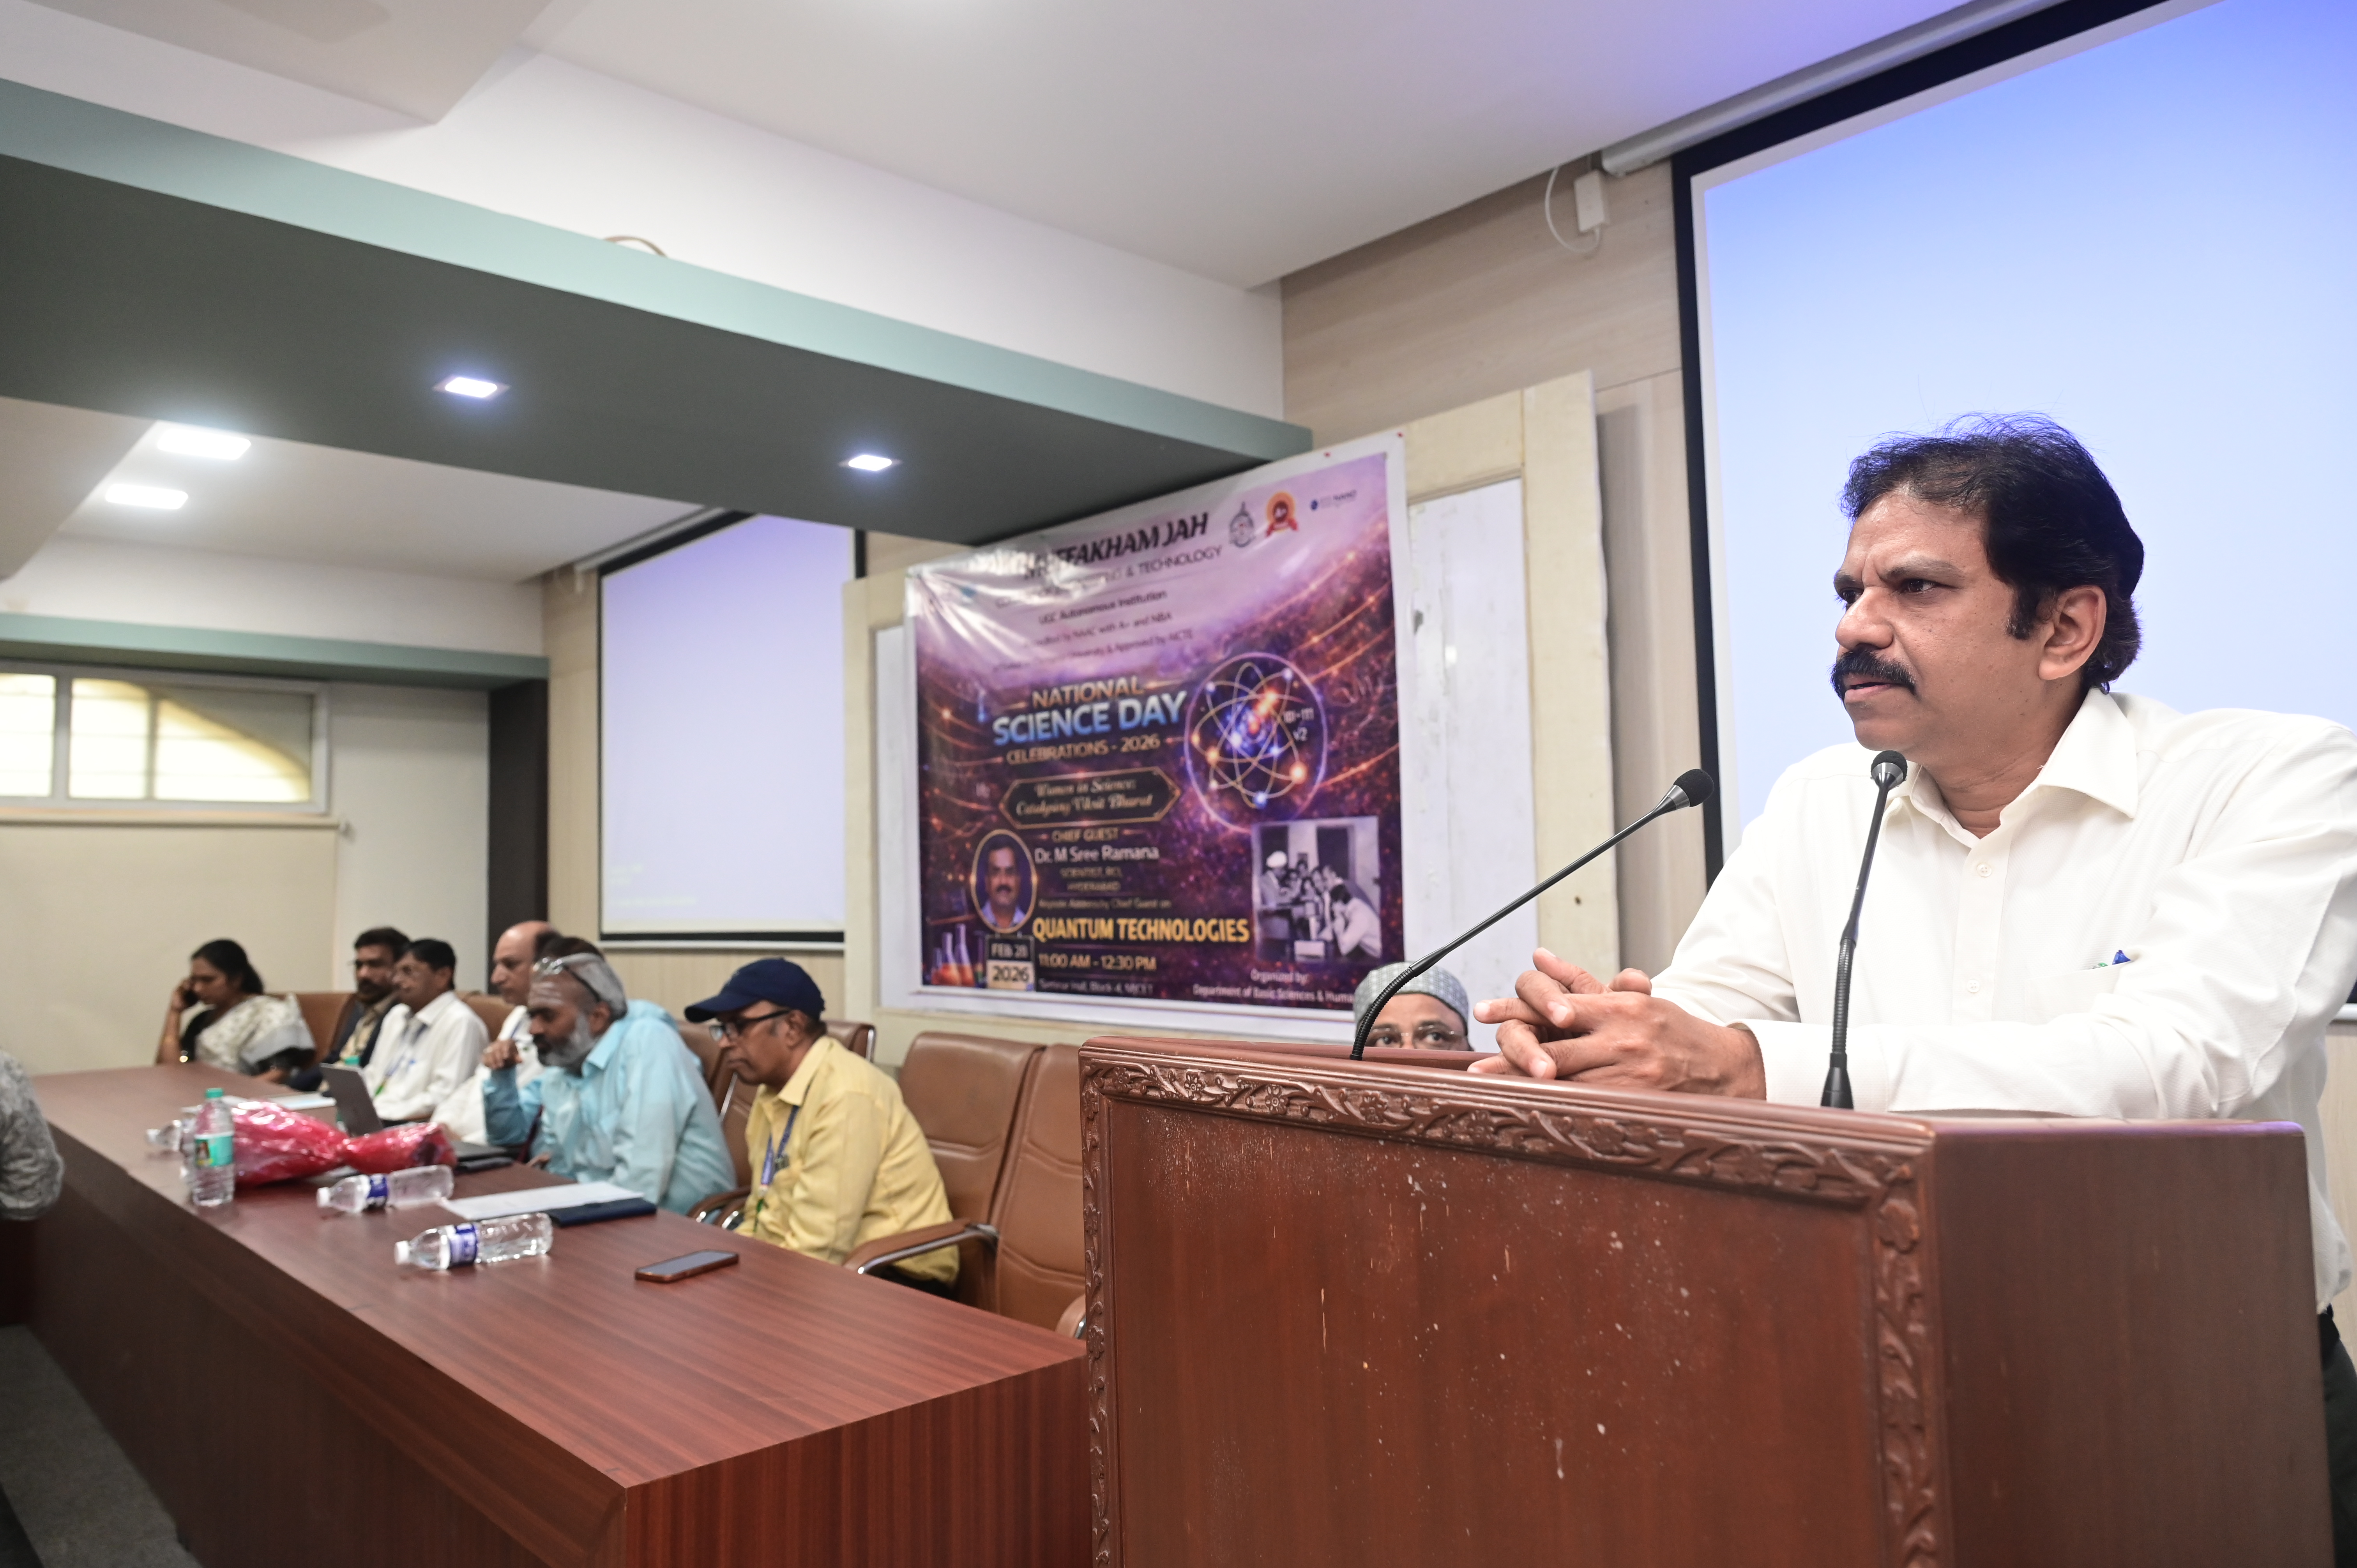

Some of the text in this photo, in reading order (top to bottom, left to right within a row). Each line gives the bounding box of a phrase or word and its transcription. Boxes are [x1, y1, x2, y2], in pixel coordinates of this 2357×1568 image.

[1161, 512, 1209, 546] JAH
[1137, 544, 1223, 574] TECHNOLOGY
[1032, 676, 1145, 709] NATIONAL
[993, 690, 1187, 745] SCIENCE DAY
[1006, 740, 1109, 765] CELEBRATIONS
[1120, 733, 1161, 753] 2026
[1052, 827, 1119, 844] CHIEF GUEST
[1034, 844, 1160, 864] Dr. M Sree Ramana
[1032, 918, 1249, 943] QUANTUM TECHNOLOGIES
[991, 943, 1013, 959] FEB
[992, 965, 1029, 982] 2026
[1069, 954, 1091, 969] AM
[1134, 955, 1157, 972] PM
[1250, 968, 1295, 985] Organized
